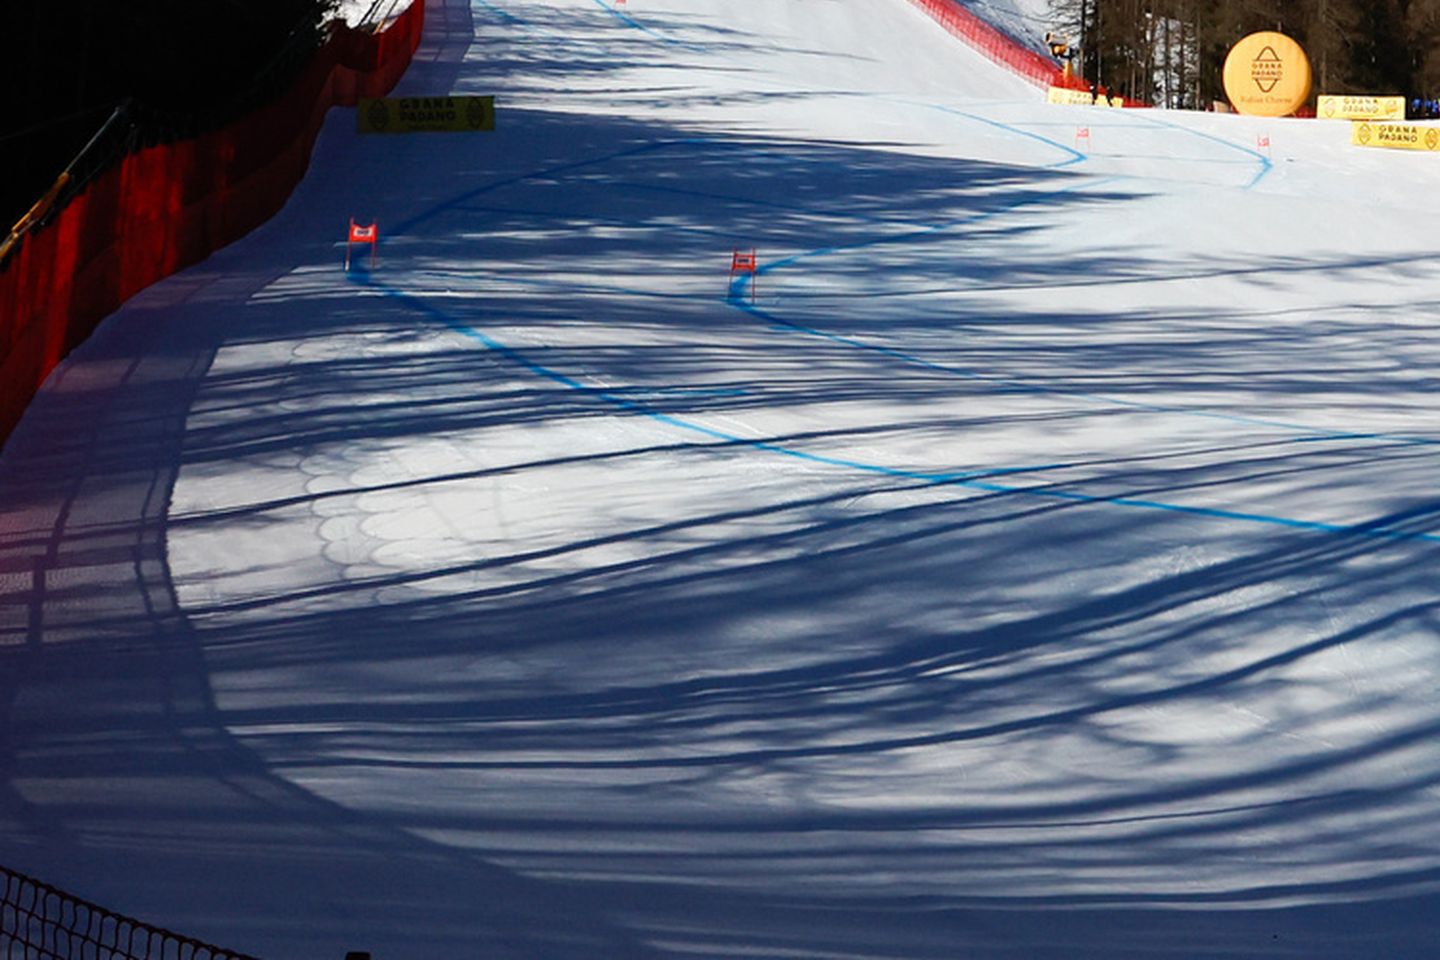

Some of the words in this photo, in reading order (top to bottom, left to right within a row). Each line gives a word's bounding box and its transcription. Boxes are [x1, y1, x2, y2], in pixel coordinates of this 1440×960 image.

[400, 98, 454, 109] GRANA
[399, 110, 455, 121] PADANO
[1379, 124, 1418, 133] GRANA
[1378, 133, 1418, 143] PADANO
